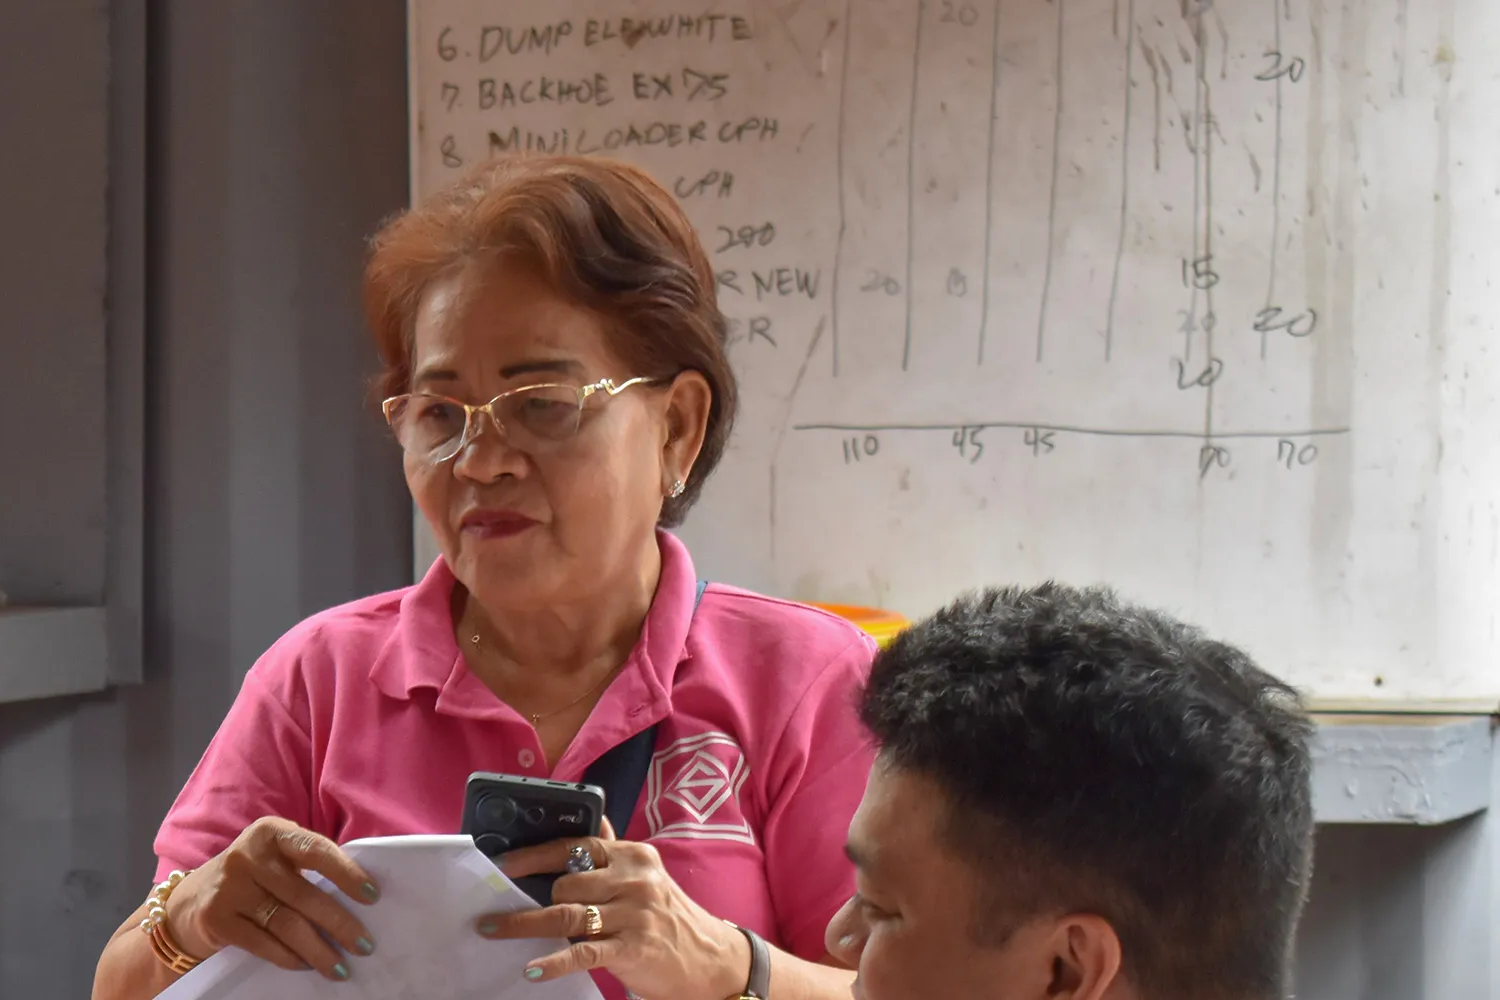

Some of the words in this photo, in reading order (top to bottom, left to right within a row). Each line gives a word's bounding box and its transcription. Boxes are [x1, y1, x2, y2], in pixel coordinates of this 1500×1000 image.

[437, 27, 471, 62] 6.
[479, 21, 573, 63] DUMP
[1254, 51, 1306, 83] 20
[478, 72, 615, 110] BACKHOE
[751, 266, 821, 302] NEW
[1181, 252, 1220, 290] 15
[1252, 305, 1318, 338] 20
[842, 434, 880, 464] 110
[951, 424, 984, 464] 45
[1023, 427, 1056, 457] 45
